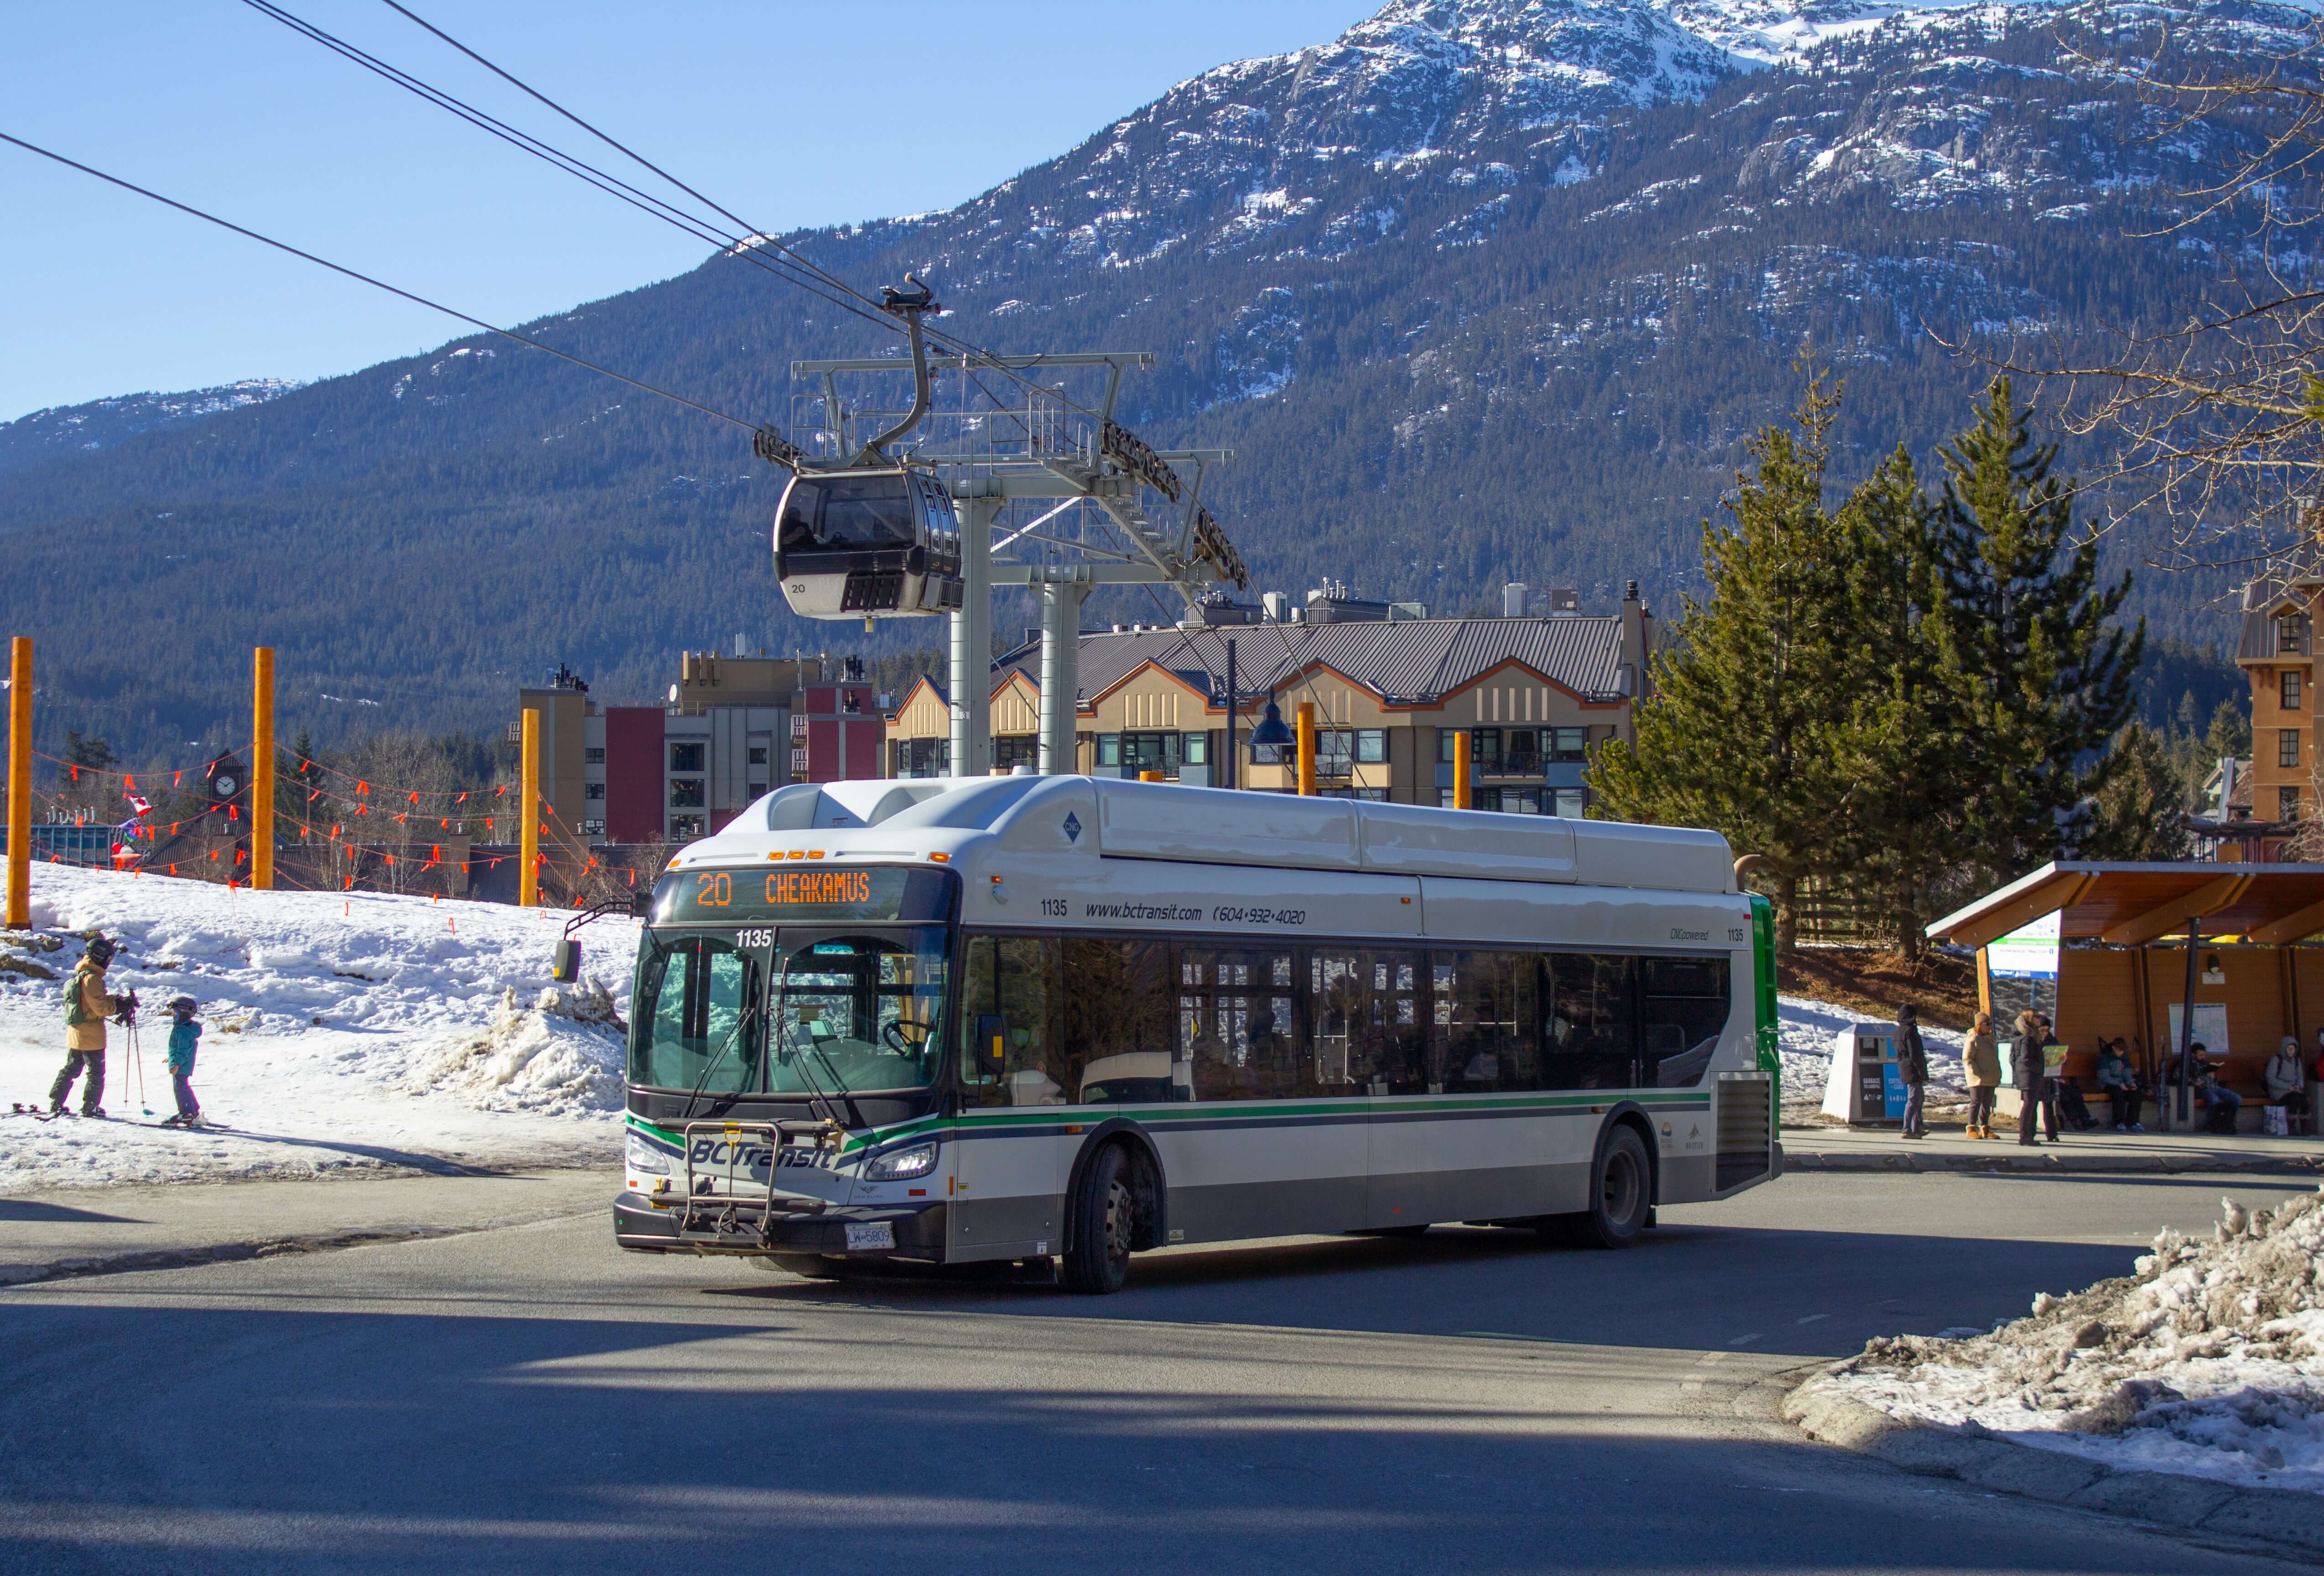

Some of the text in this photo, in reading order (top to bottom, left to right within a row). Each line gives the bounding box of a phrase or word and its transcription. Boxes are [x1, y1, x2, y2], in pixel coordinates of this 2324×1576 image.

[792, 584, 805, 593] 20
[1065, 822, 1079, 832] CNG
[697, 872, 870, 906] 20 CHEAKAMUS
[1041, 899, 1067, 916] 1135
[1086, 902, 1202, 921] www.bctransit.com
[737, 929, 772, 948] 1135
[1727, 928, 1743, 942] 1135
[847, 1230, 890, 1243] LW 5809
